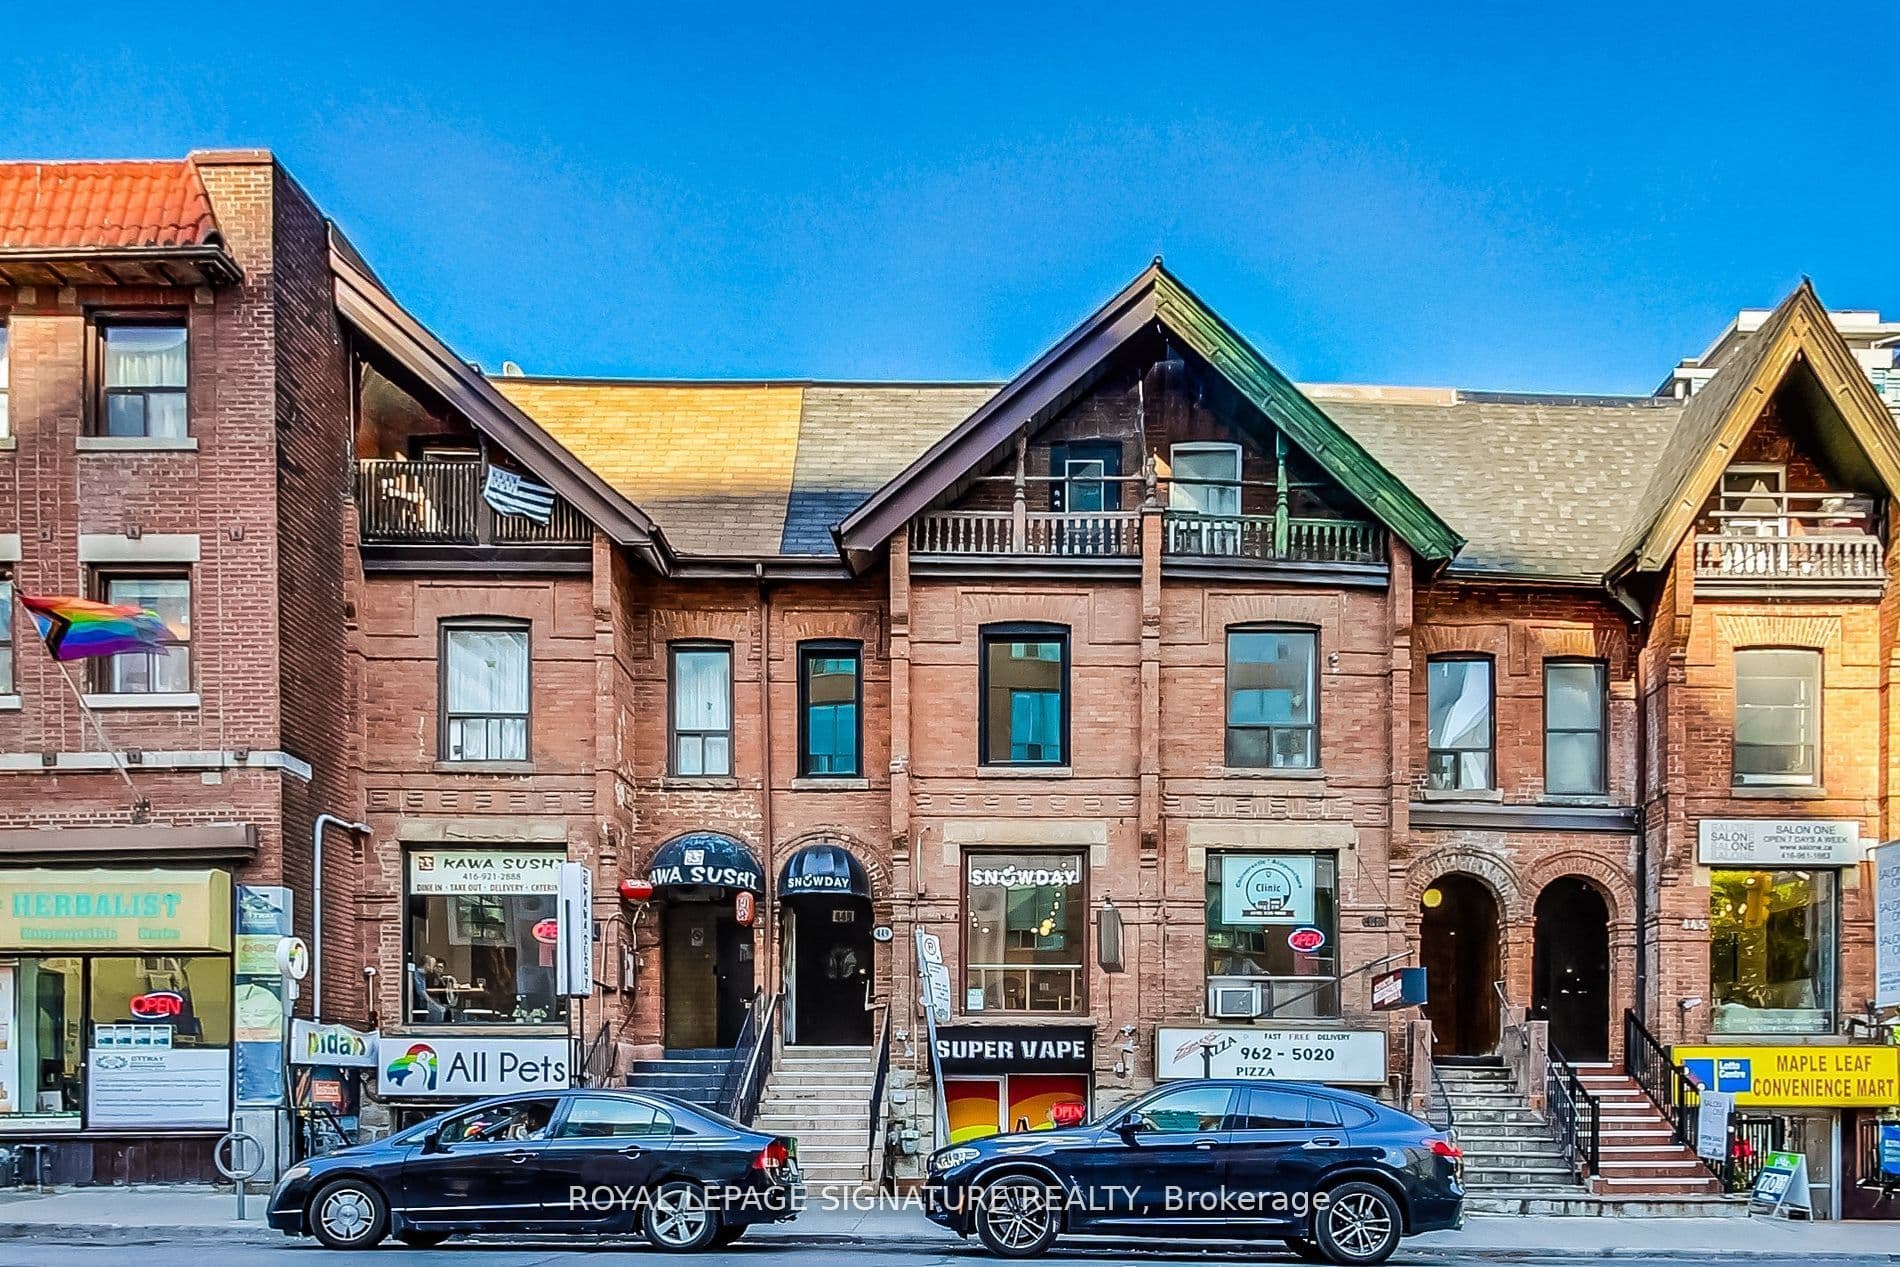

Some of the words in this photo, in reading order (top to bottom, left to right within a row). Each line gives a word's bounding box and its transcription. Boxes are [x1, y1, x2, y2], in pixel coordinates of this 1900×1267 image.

[1711, 832, 1748, 841] SALON
[1775, 825, 1811, 835] SALON
[1813, 826, 1837, 835] ONE
[443, 859, 494, 869] KAWA
[649, 867, 683, 886] AWA
[690, 867, 757, 890] SUSHI
[787, 874, 849, 888] SNOWDAY
[971, 864, 1077, 887] SNOWDAY
[1256, 883, 1281, 892] Clinic
[12, 892, 182, 918] HERBALIST
[1293, 932, 1322, 946] OPEN
[131, 996, 181, 1015] OPEN
[936, 1040, 1014, 1059] SUPER
[1022, 1040, 1086, 1059] VAPE
[1240, 1047, 1273, 1060] 962
[1292, 1048, 1335, 1061] 5020
[446, 1052, 486, 1082] All
[500, 1052, 566, 1082] Pets
[1719, 1061, 1741, 1069] Lotto
[1776, 1055, 1827, 1072] MAPLE
[1835, 1055, 1873, 1072] LEAF
[1236, 1067, 1275, 1077] PIZZA
[1753, 1078, 1851, 1097] CONVENIENCE
[1856, 1078, 1894, 1097] MART
[1053, 1106, 1083, 1118] OPEN
